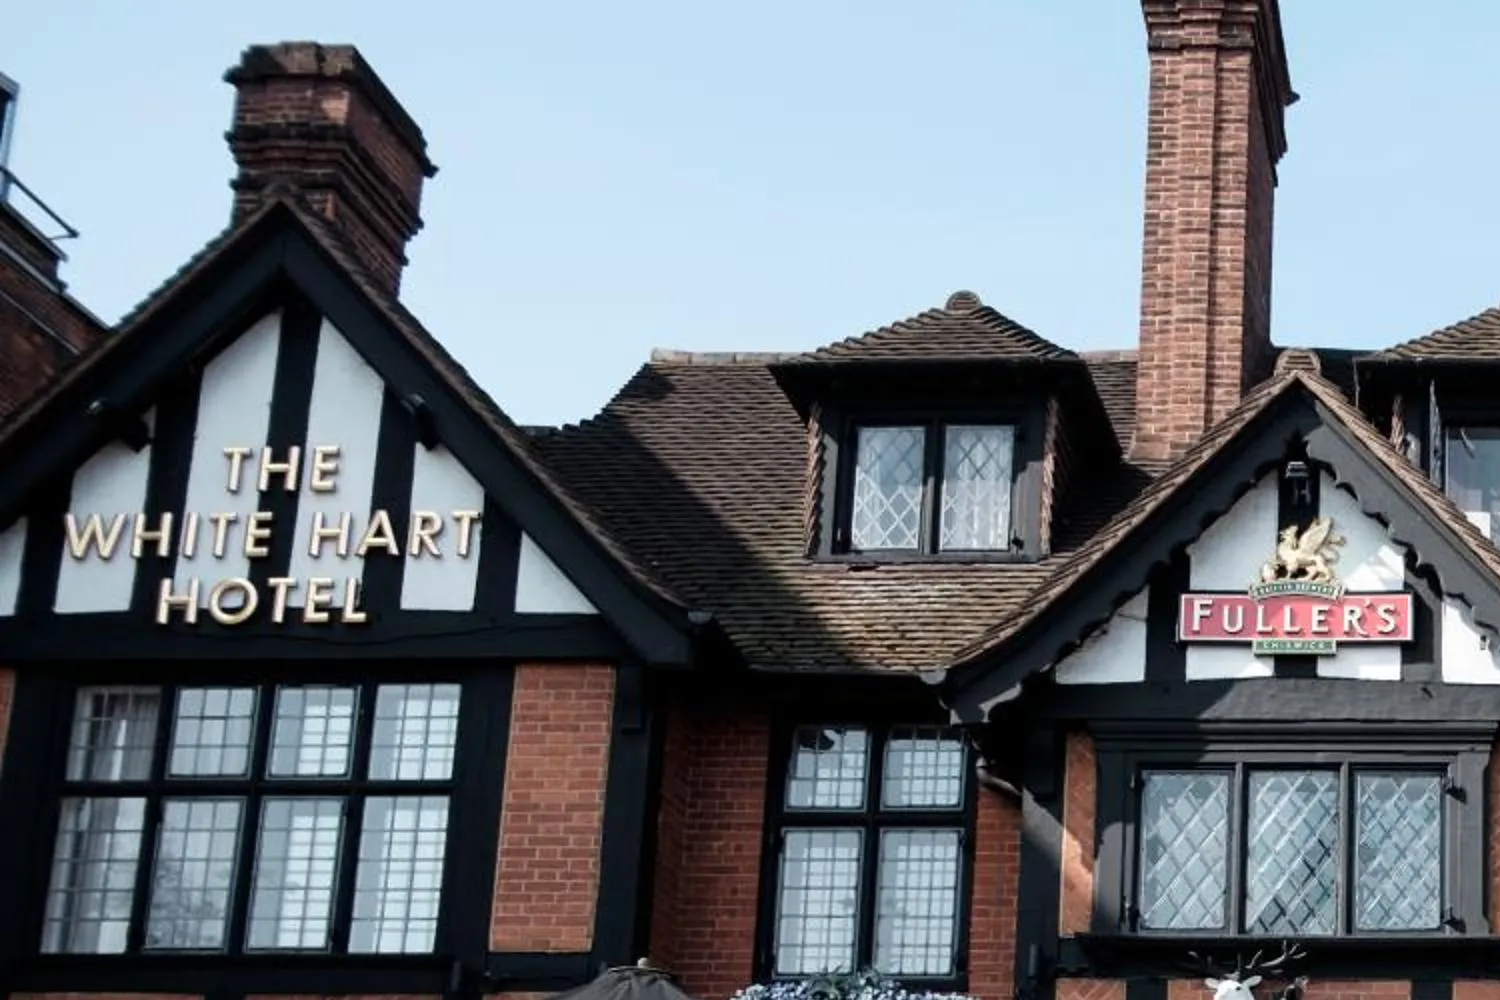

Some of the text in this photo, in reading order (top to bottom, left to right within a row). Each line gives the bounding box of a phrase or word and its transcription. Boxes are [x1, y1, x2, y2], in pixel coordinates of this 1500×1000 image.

[222, 445, 343, 493] THE
[64, 509, 482, 560] WHITE HART
[155, 577, 368, 625] HOTEL
[1190, 599, 1398, 638] FULLER'S
